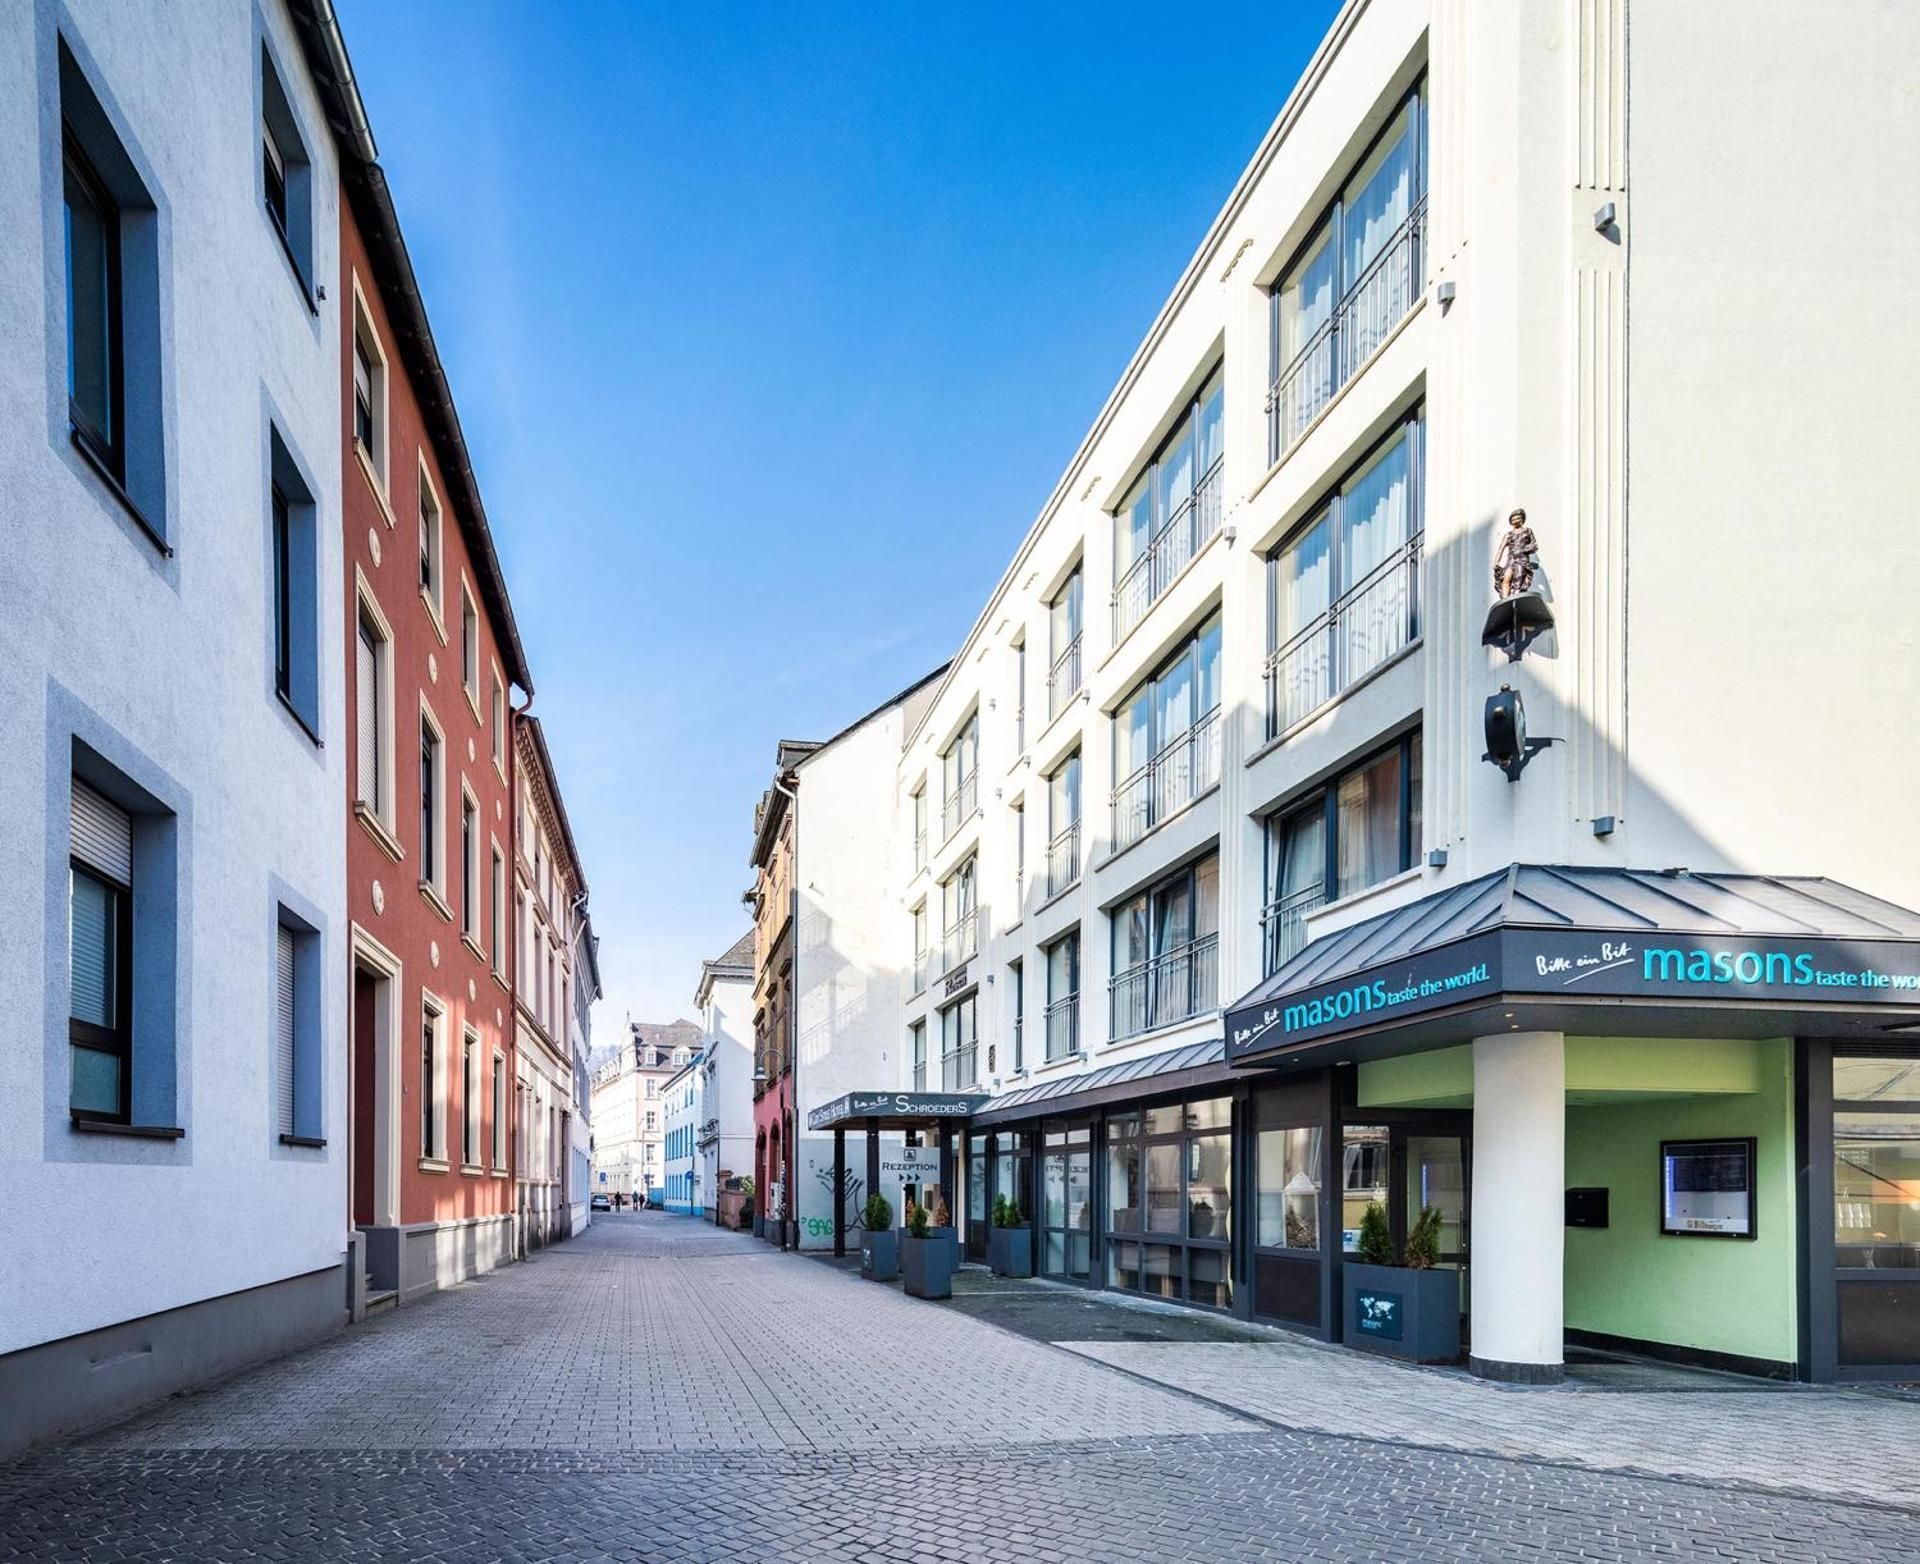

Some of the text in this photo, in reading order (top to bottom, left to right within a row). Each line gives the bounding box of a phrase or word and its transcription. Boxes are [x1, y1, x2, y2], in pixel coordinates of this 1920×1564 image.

[1536, 942, 1633, 976] Bitte ein Bit
[1643, 949, 1814, 985] masons
[1815, 970, 1858, 986] taste
[1860, 969, 1890, 987] the
[1284, 963, 1491, 1033] masons taste the world.
